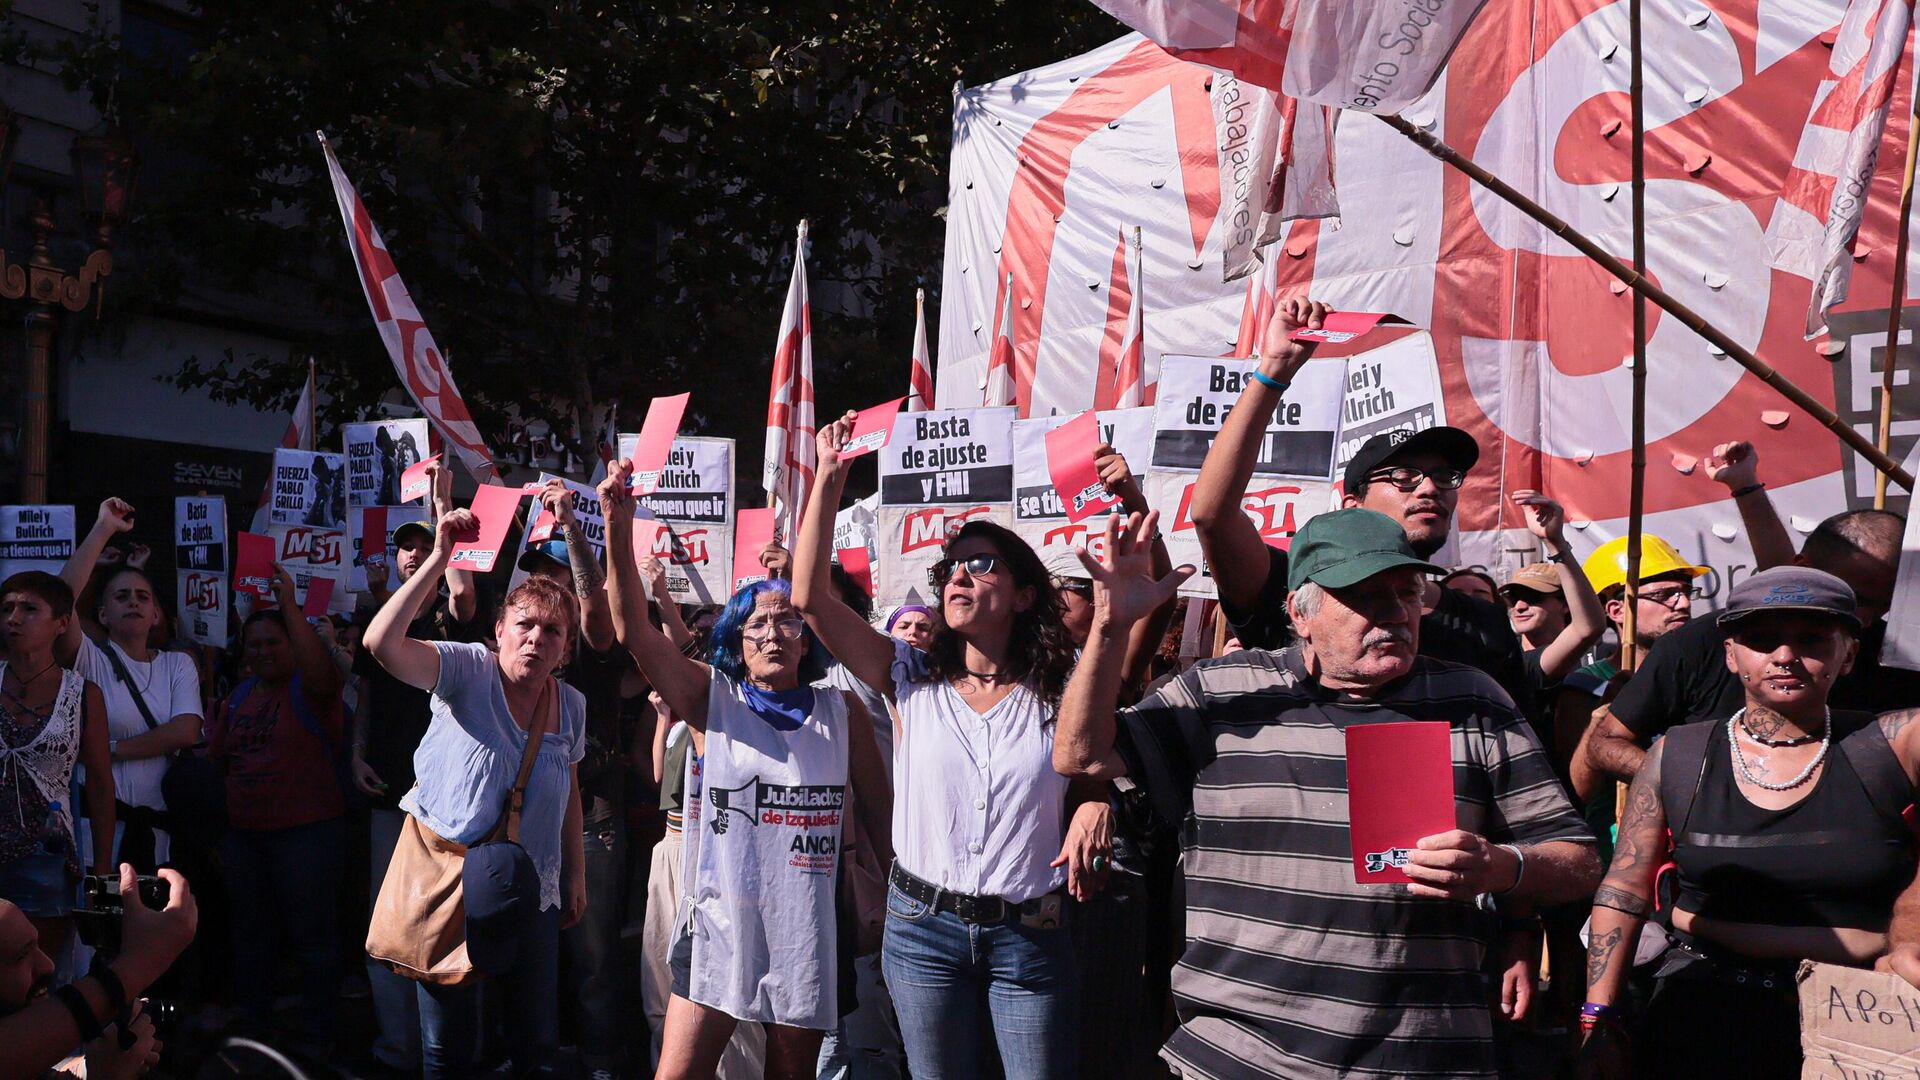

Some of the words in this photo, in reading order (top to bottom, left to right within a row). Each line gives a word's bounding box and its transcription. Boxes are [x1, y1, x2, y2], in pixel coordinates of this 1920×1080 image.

[1378, 0, 1442, 55] Socia
[1209, 365, 1254, 393] Bas
[1370, 363, 1382, 389] y
[1186, 396, 1216, 425] de
[916, 416, 970, 441] Basta
[349, 442, 374, 458] FUERZA
[686, 451, 694, 469] y
[902, 445, 925, 469] de
[928, 442, 987, 470] ajuste
[174, 462, 242, 480] SEVEN
[277, 466, 309, 481] FUERZA
[349, 459, 372, 475] PABLO
[276, 481, 304, 495] PABLO
[350, 474, 374, 491] GRILLO
[920, 478, 933, 502] y
[935, 470, 970, 497] FMI
[187, 502, 208, 521] Basta
[275, 496, 304, 509] GRILLO
[685, 500, 709, 520] que
[712, 496, 725, 516] ir
[1020, 494, 1040, 517] se
[18, 510, 42, 523] Milei
[44, 511, 51, 525] y
[15, 525, 54, 539] Bullrich
[181, 523, 191, 542] de
[192, 522, 213, 545] ajuste
[9, 543, 41, 557] tienen
[42, 545, 61, 558] que
[62, 542, 71, 555] ir
[188, 550, 194, 568] y
[194, 545, 208, 566] FMI
[283, 529, 344, 565] MST
[652, 529, 708, 564] MST
[187, 575, 219, 610] MST
[761, 786, 843, 807] Jubiladxs
[761, 809, 783, 825] de
